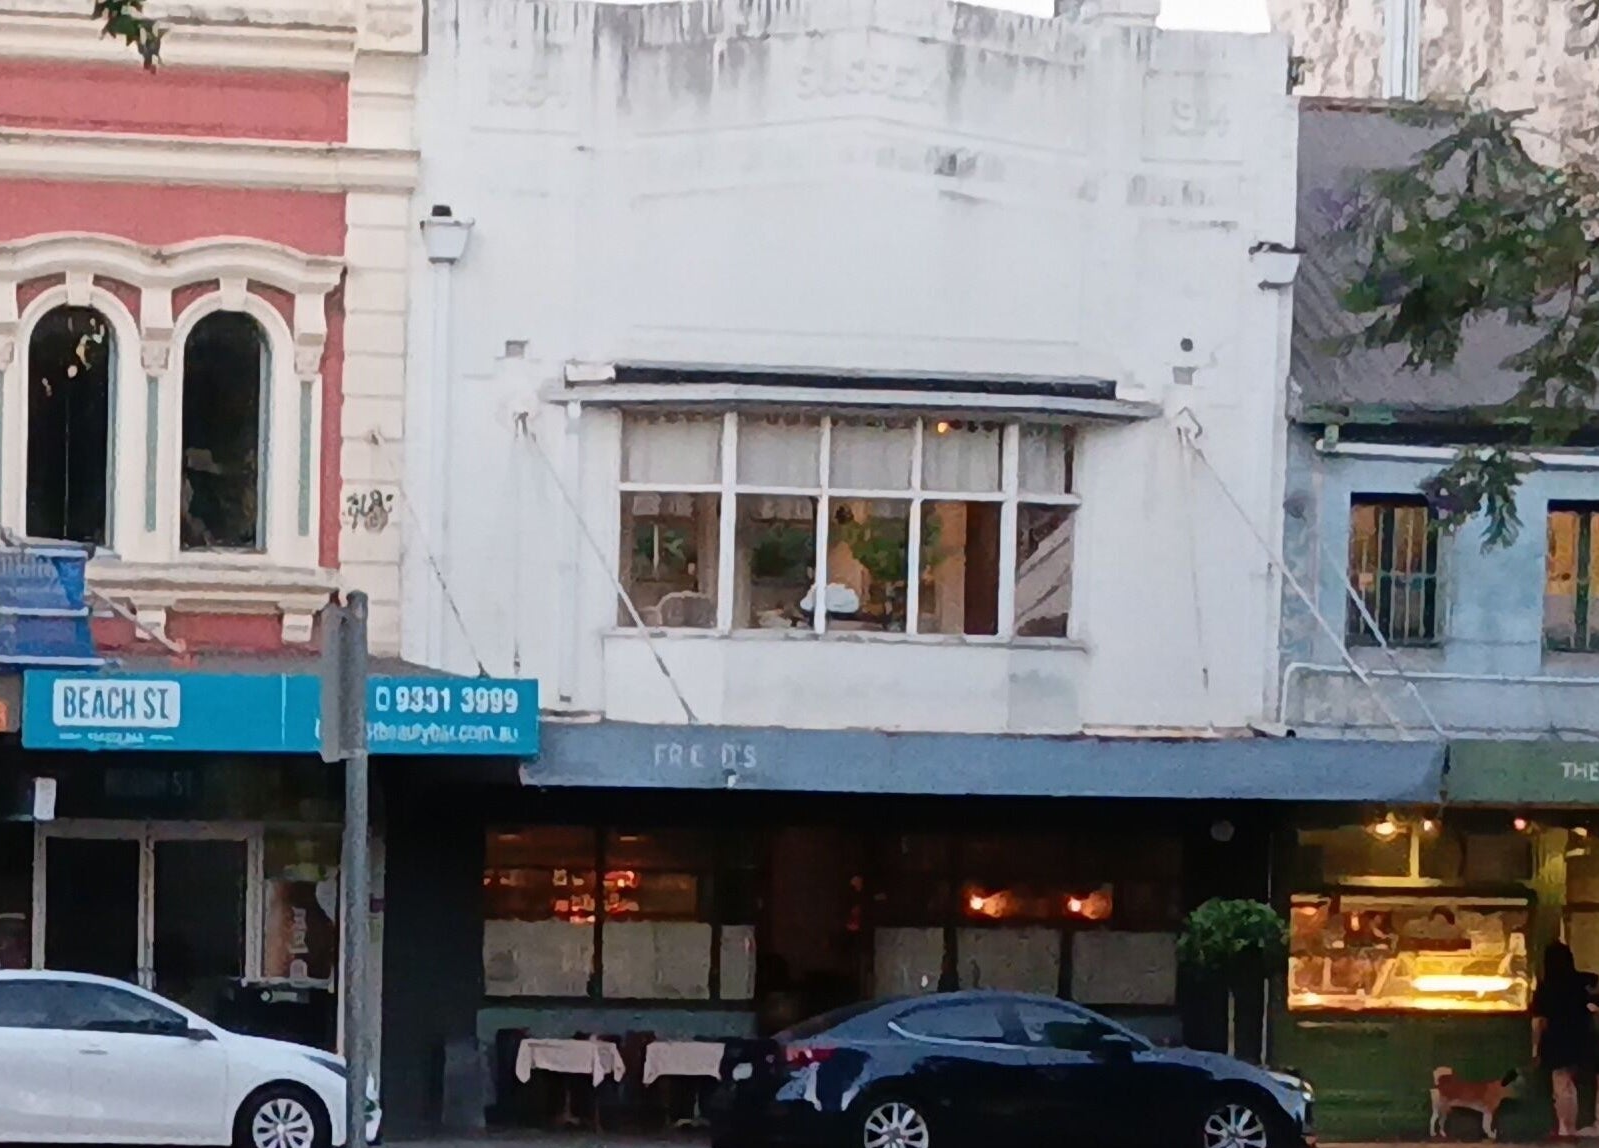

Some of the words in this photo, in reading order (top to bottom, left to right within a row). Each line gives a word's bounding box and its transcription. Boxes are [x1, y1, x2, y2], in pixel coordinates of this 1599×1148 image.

[63, 685, 137, 720] BEACH
[142, 687, 169, 721] ST
[1560, 762, 1599, 781] THE
